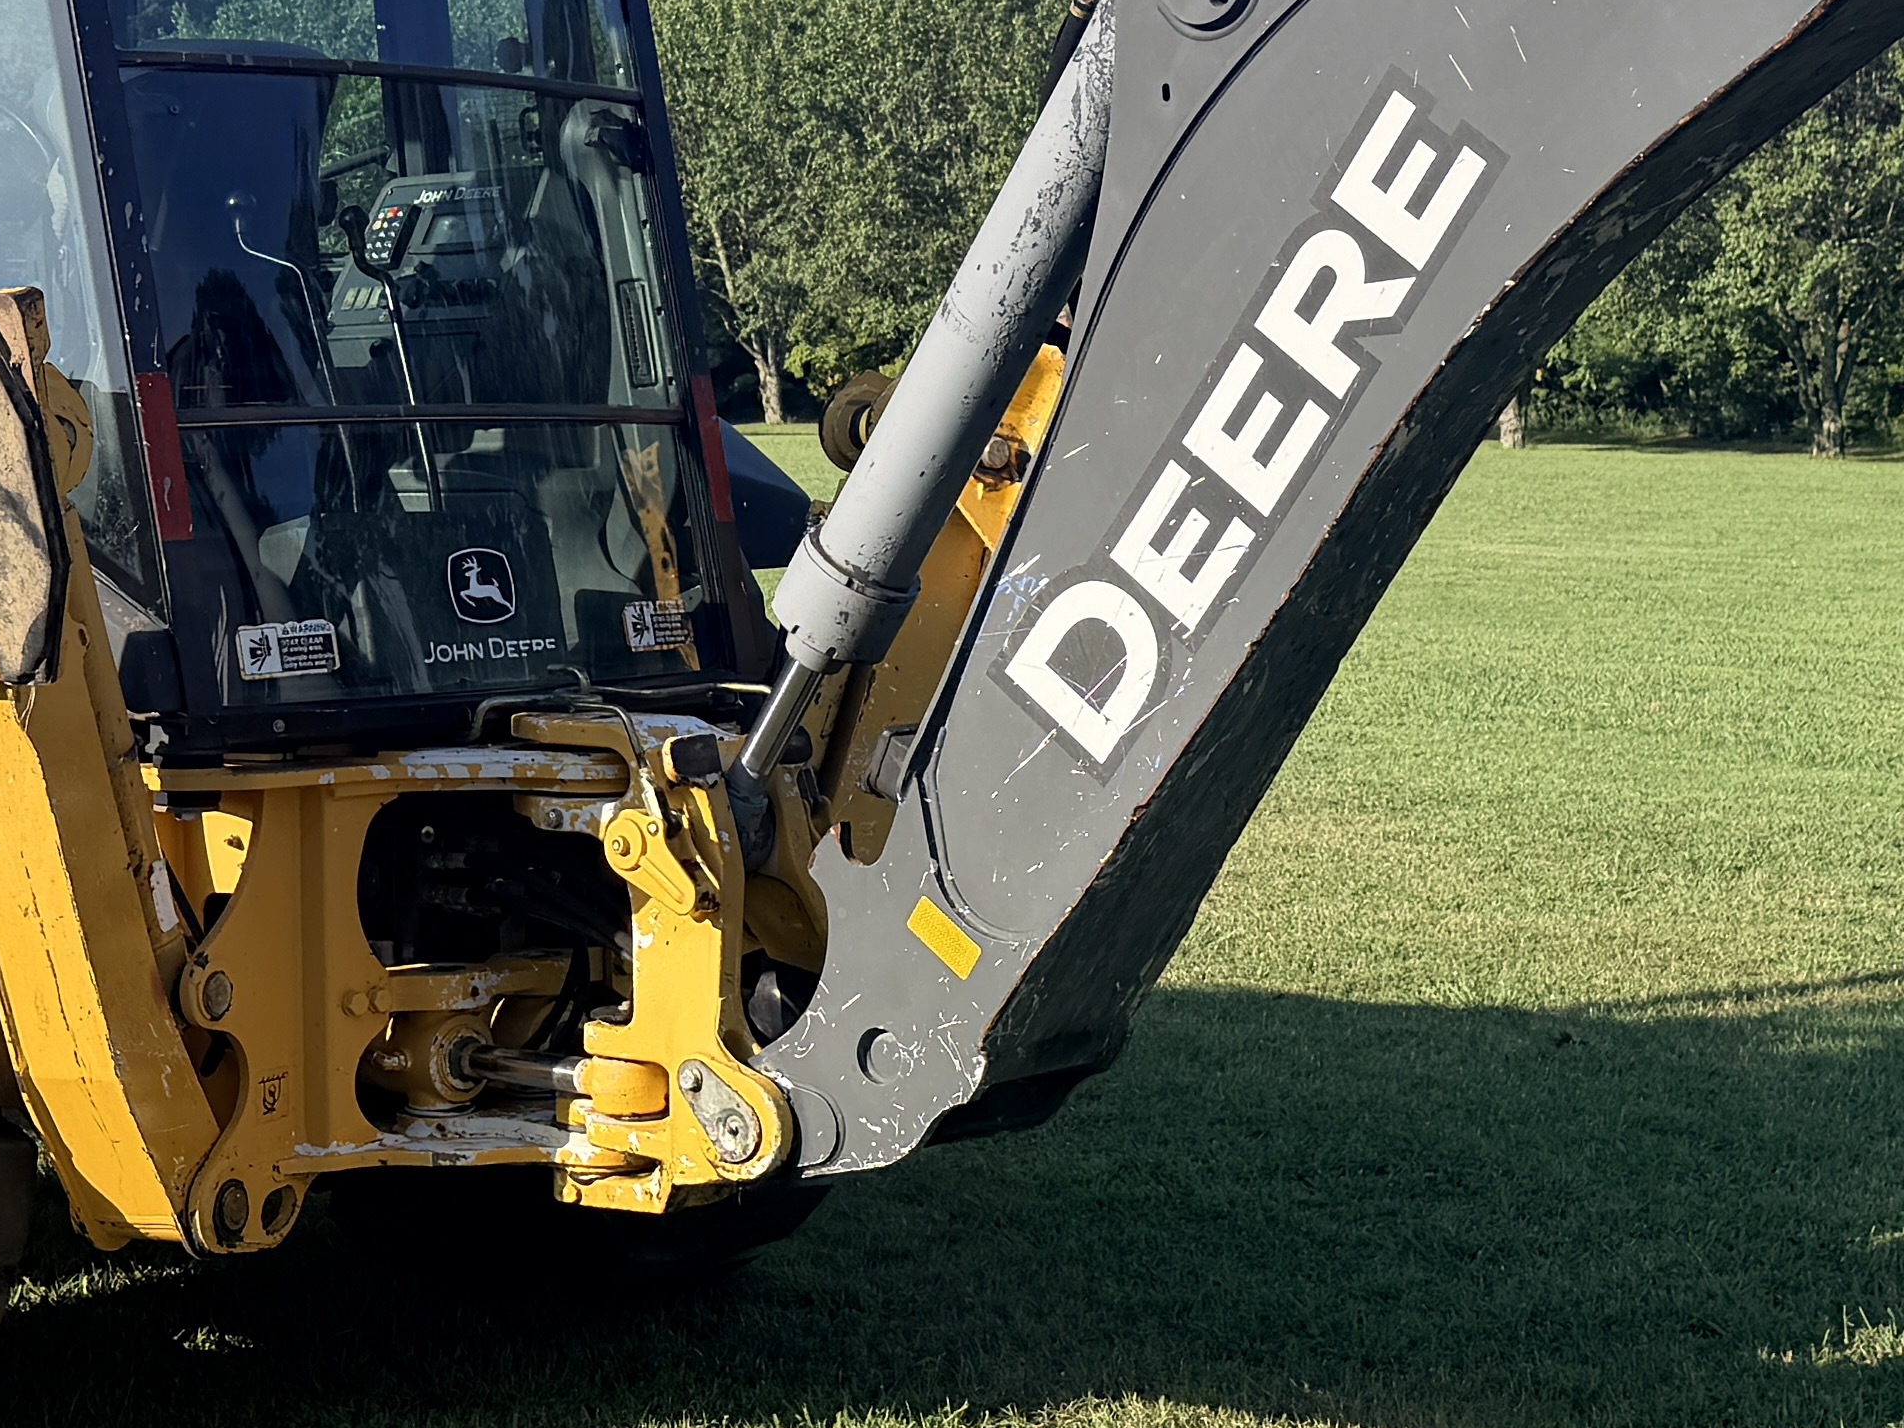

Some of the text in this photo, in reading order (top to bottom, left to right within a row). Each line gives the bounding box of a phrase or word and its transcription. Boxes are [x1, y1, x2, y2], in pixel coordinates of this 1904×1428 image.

[413, 189, 453, 205] JOHN
[1004, 90, 1488, 765] DEERE
[424, 637, 556, 664] JOHN DEERE
